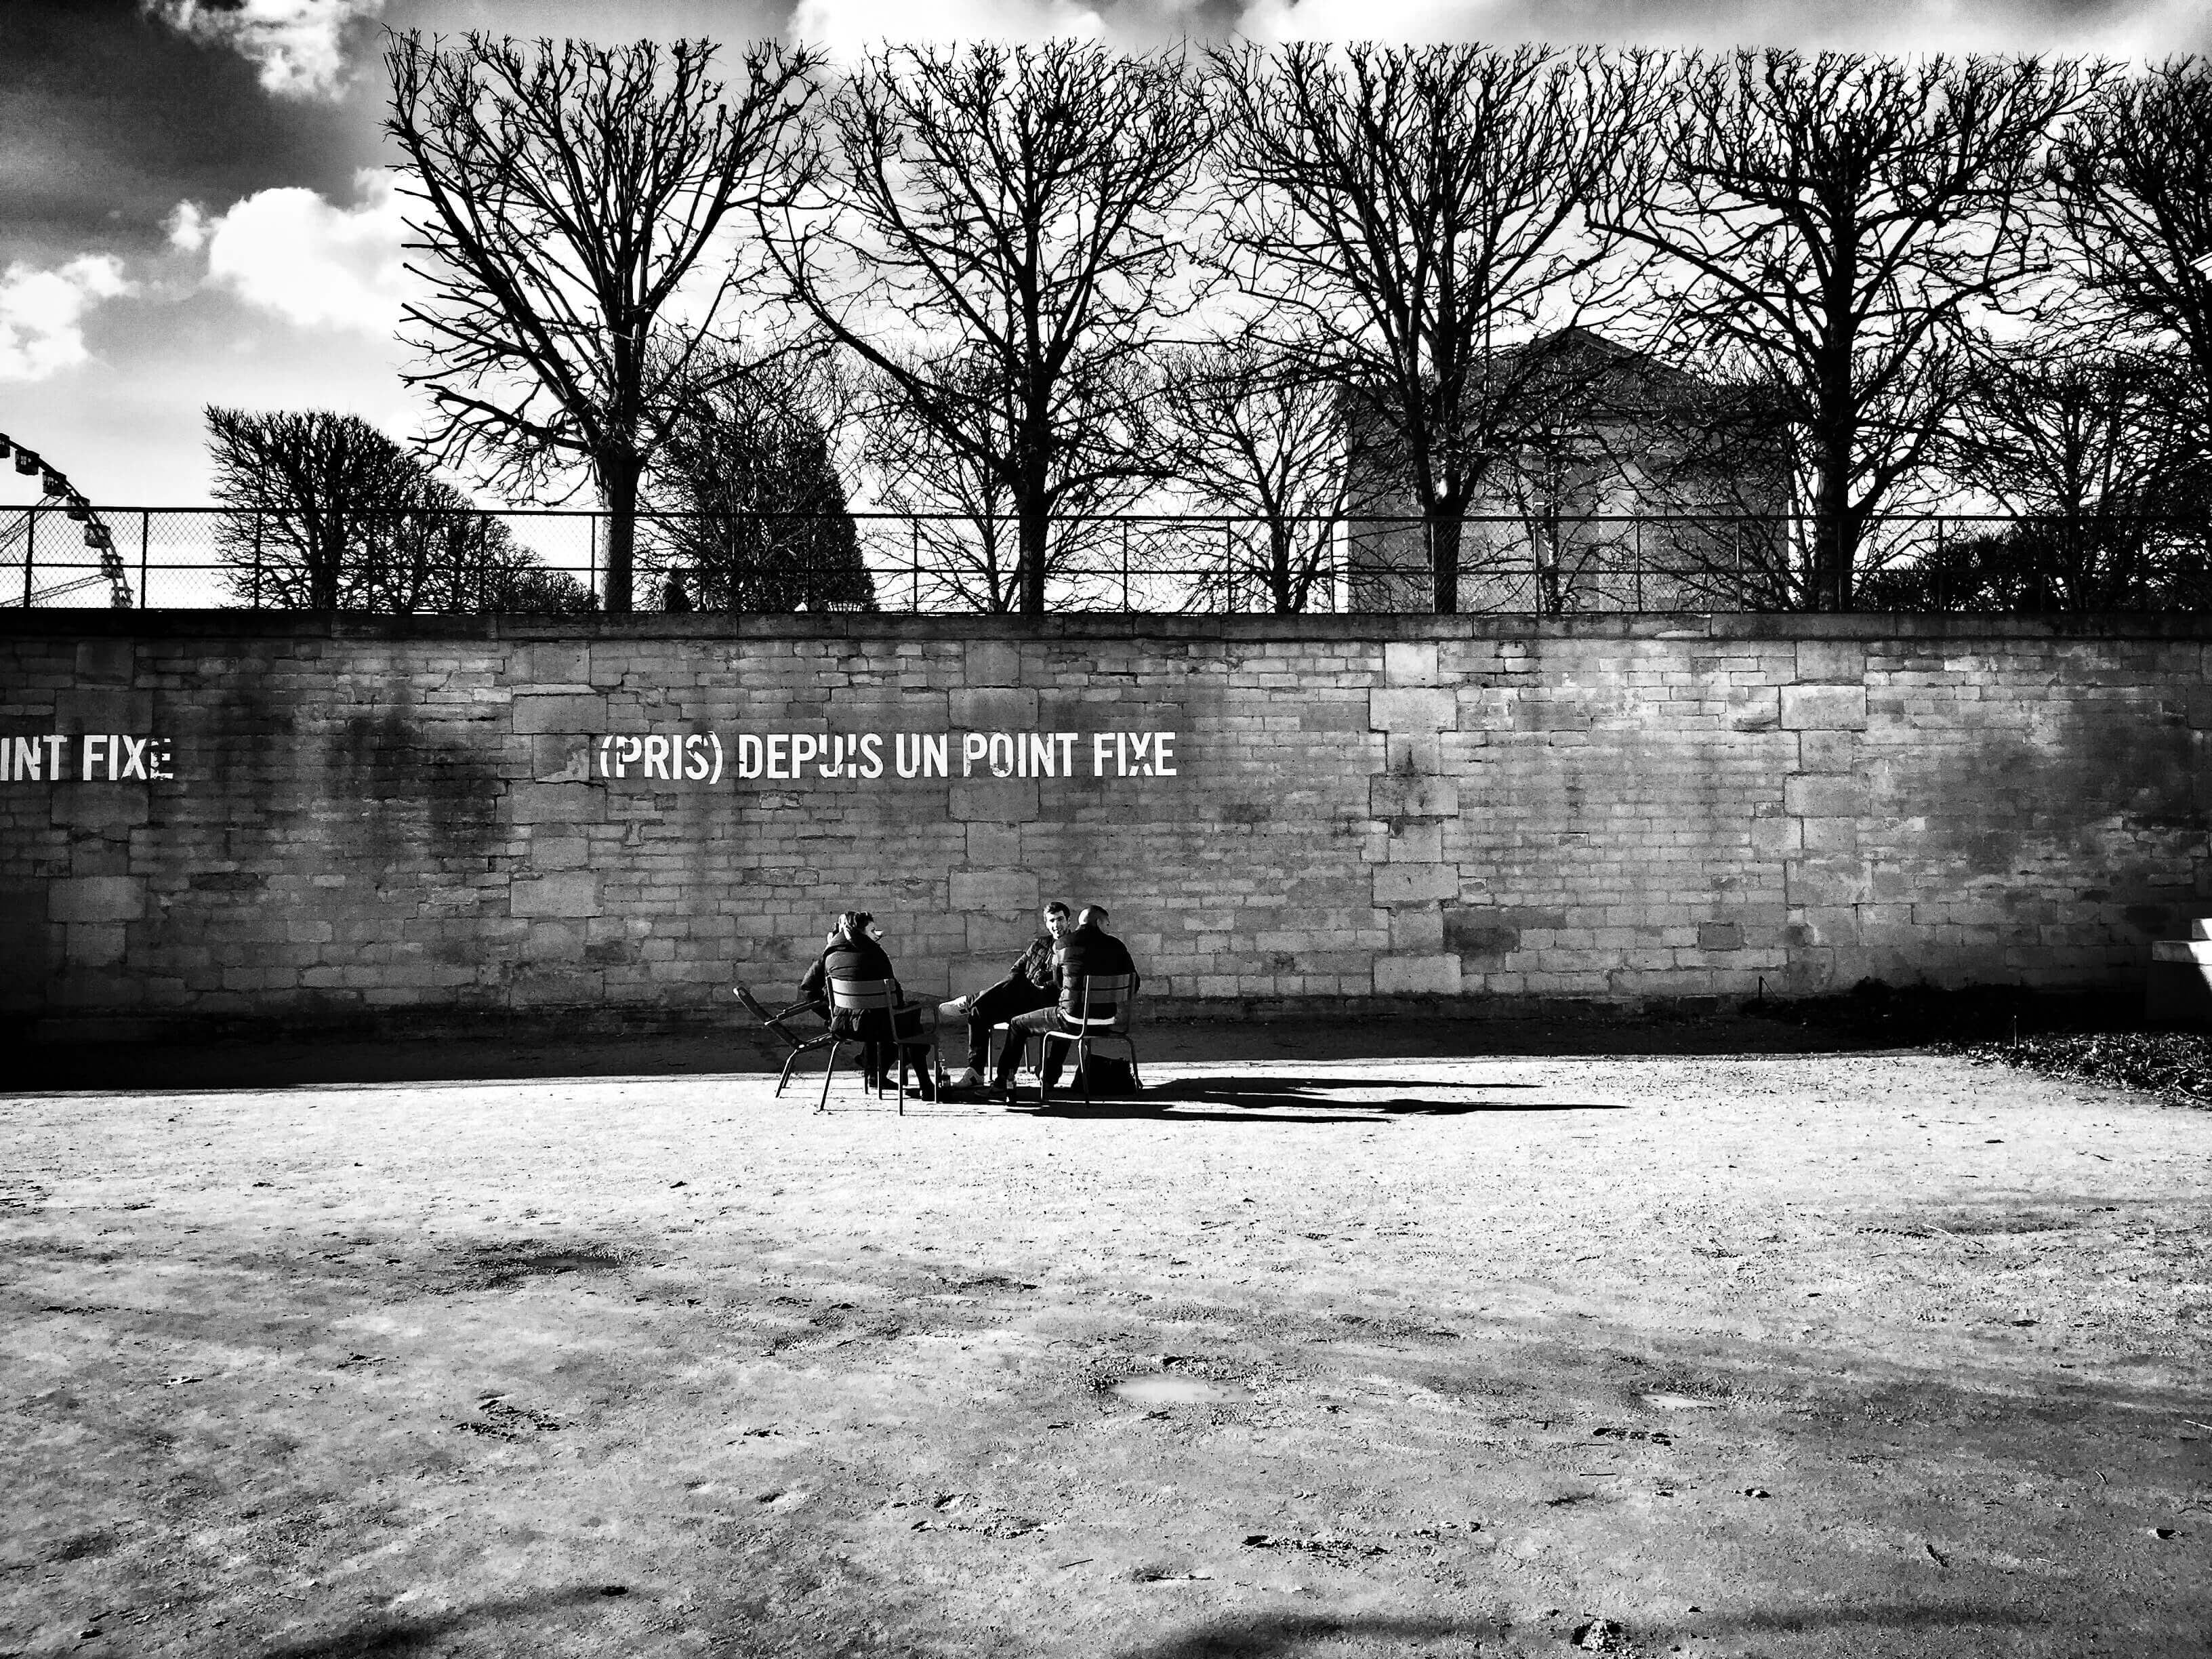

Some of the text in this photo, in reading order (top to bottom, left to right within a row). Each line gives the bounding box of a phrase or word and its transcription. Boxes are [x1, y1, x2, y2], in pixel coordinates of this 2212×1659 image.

[0, 735, 173, 781] INT FIXE
[600, 731, 1177, 784] (PRIS) DEPUIS UN POINT FIXE
